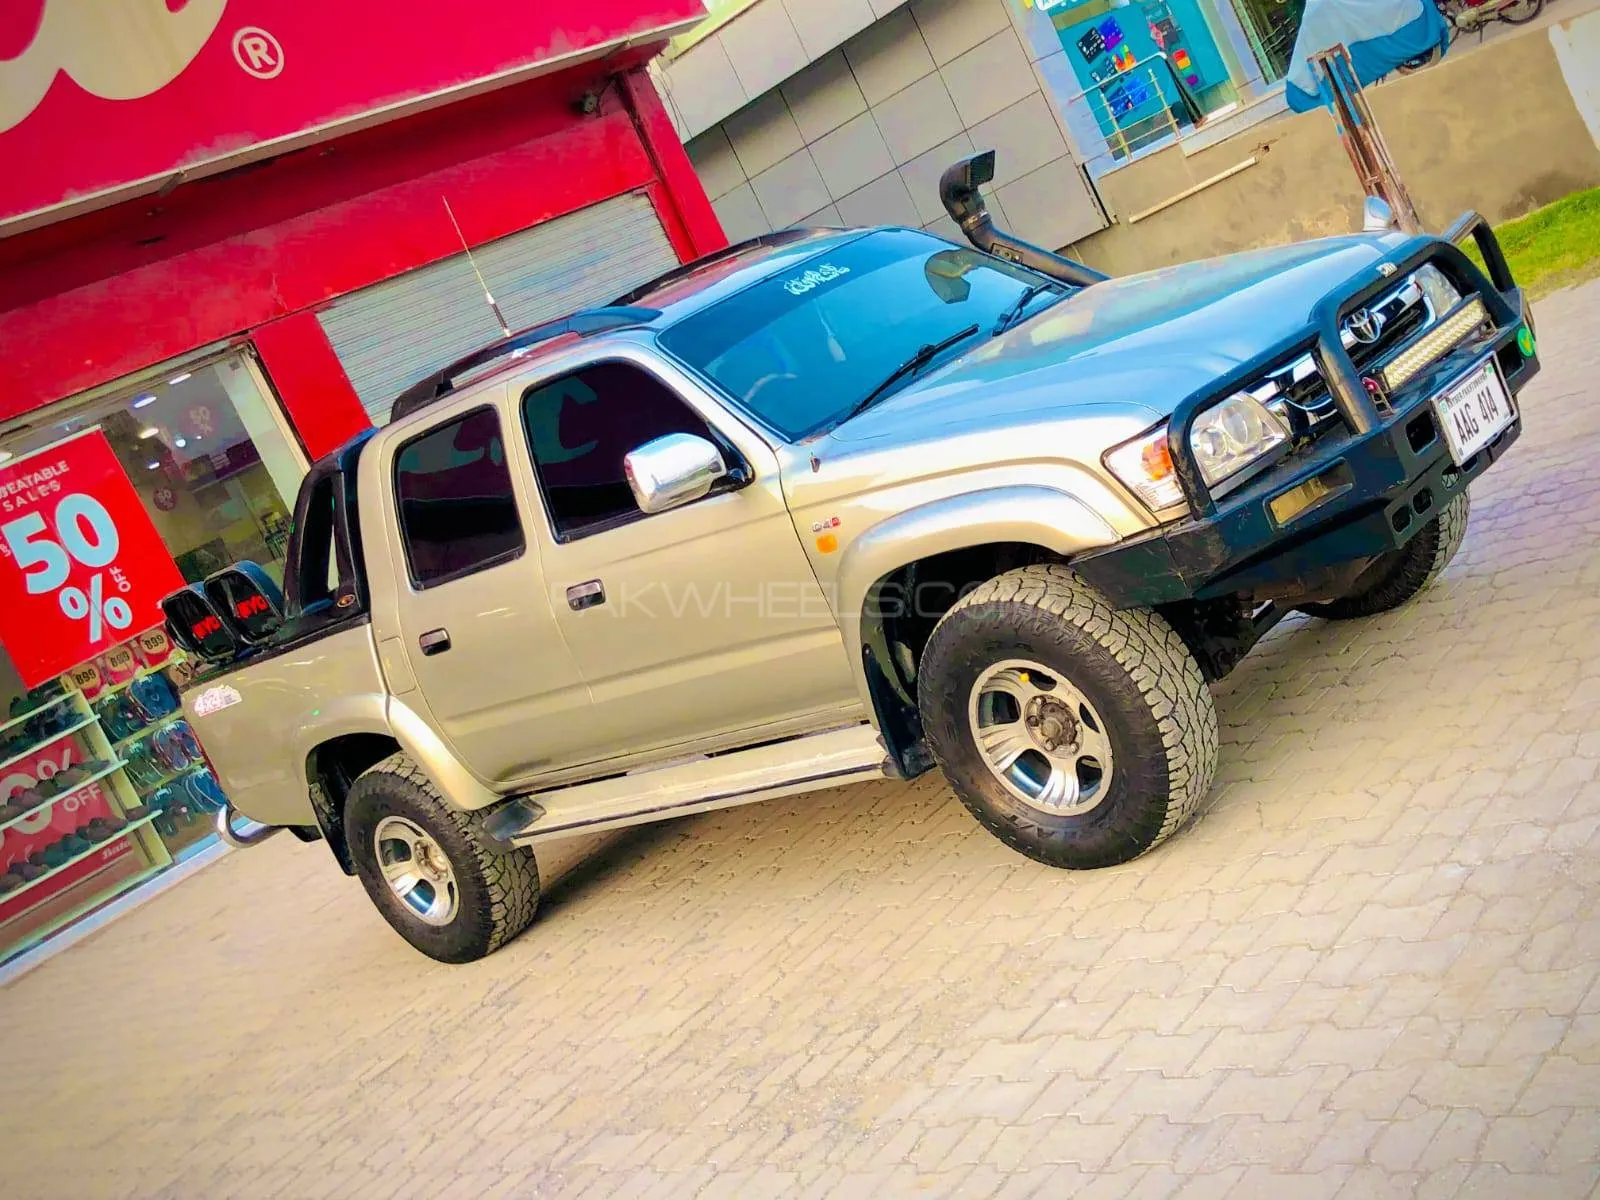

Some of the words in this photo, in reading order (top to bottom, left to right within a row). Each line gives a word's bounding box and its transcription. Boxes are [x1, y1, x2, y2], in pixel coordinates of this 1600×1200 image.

[1453, 403, 1479, 445] AAG
[1477, 385, 1499, 424] 414
[2, 479, 61, 512] SALES
[109, 566, 132, 593] OFF
[144, 634, 165, 650] 899
[75, 668, 97, 686] 899
[63, 782, 101, 812] OFF
